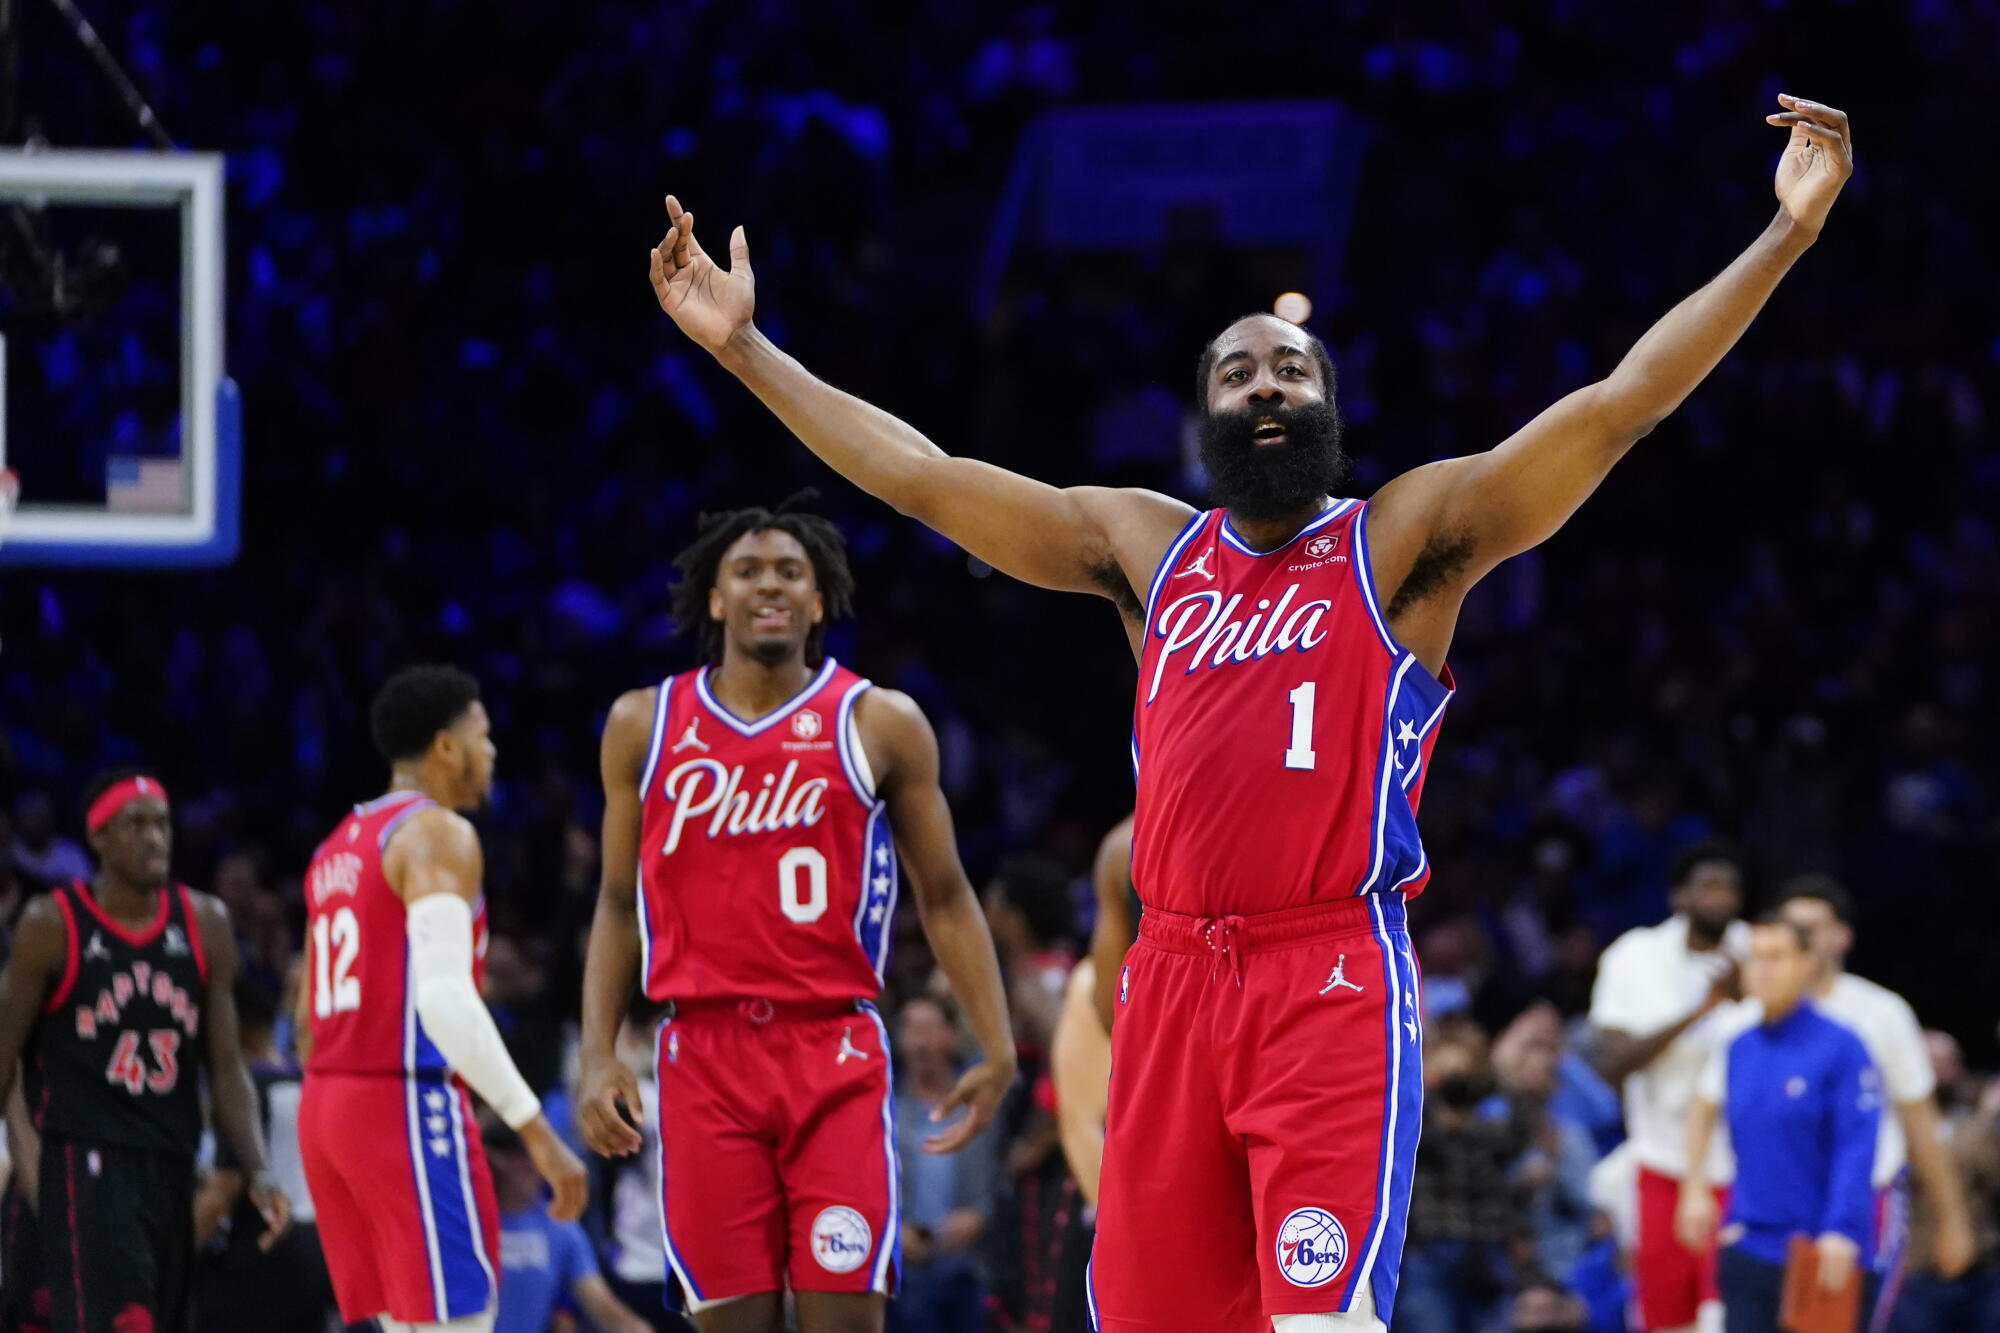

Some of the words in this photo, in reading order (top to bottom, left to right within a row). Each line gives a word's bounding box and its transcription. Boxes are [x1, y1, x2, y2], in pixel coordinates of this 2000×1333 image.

[1288, 555, 1348, 571] crypto.com
[1146, 584, 1332, 706] Phila
[1285, 681, 1316, 770] 1
[662, 758, 829, 856] Phila
[778, 846, 828, 923] 0
[313, 906, 361, 1019] 12
[106, 1028, 181, 1096] 43
[1283, 1238, 1340, 1267] 76ers
